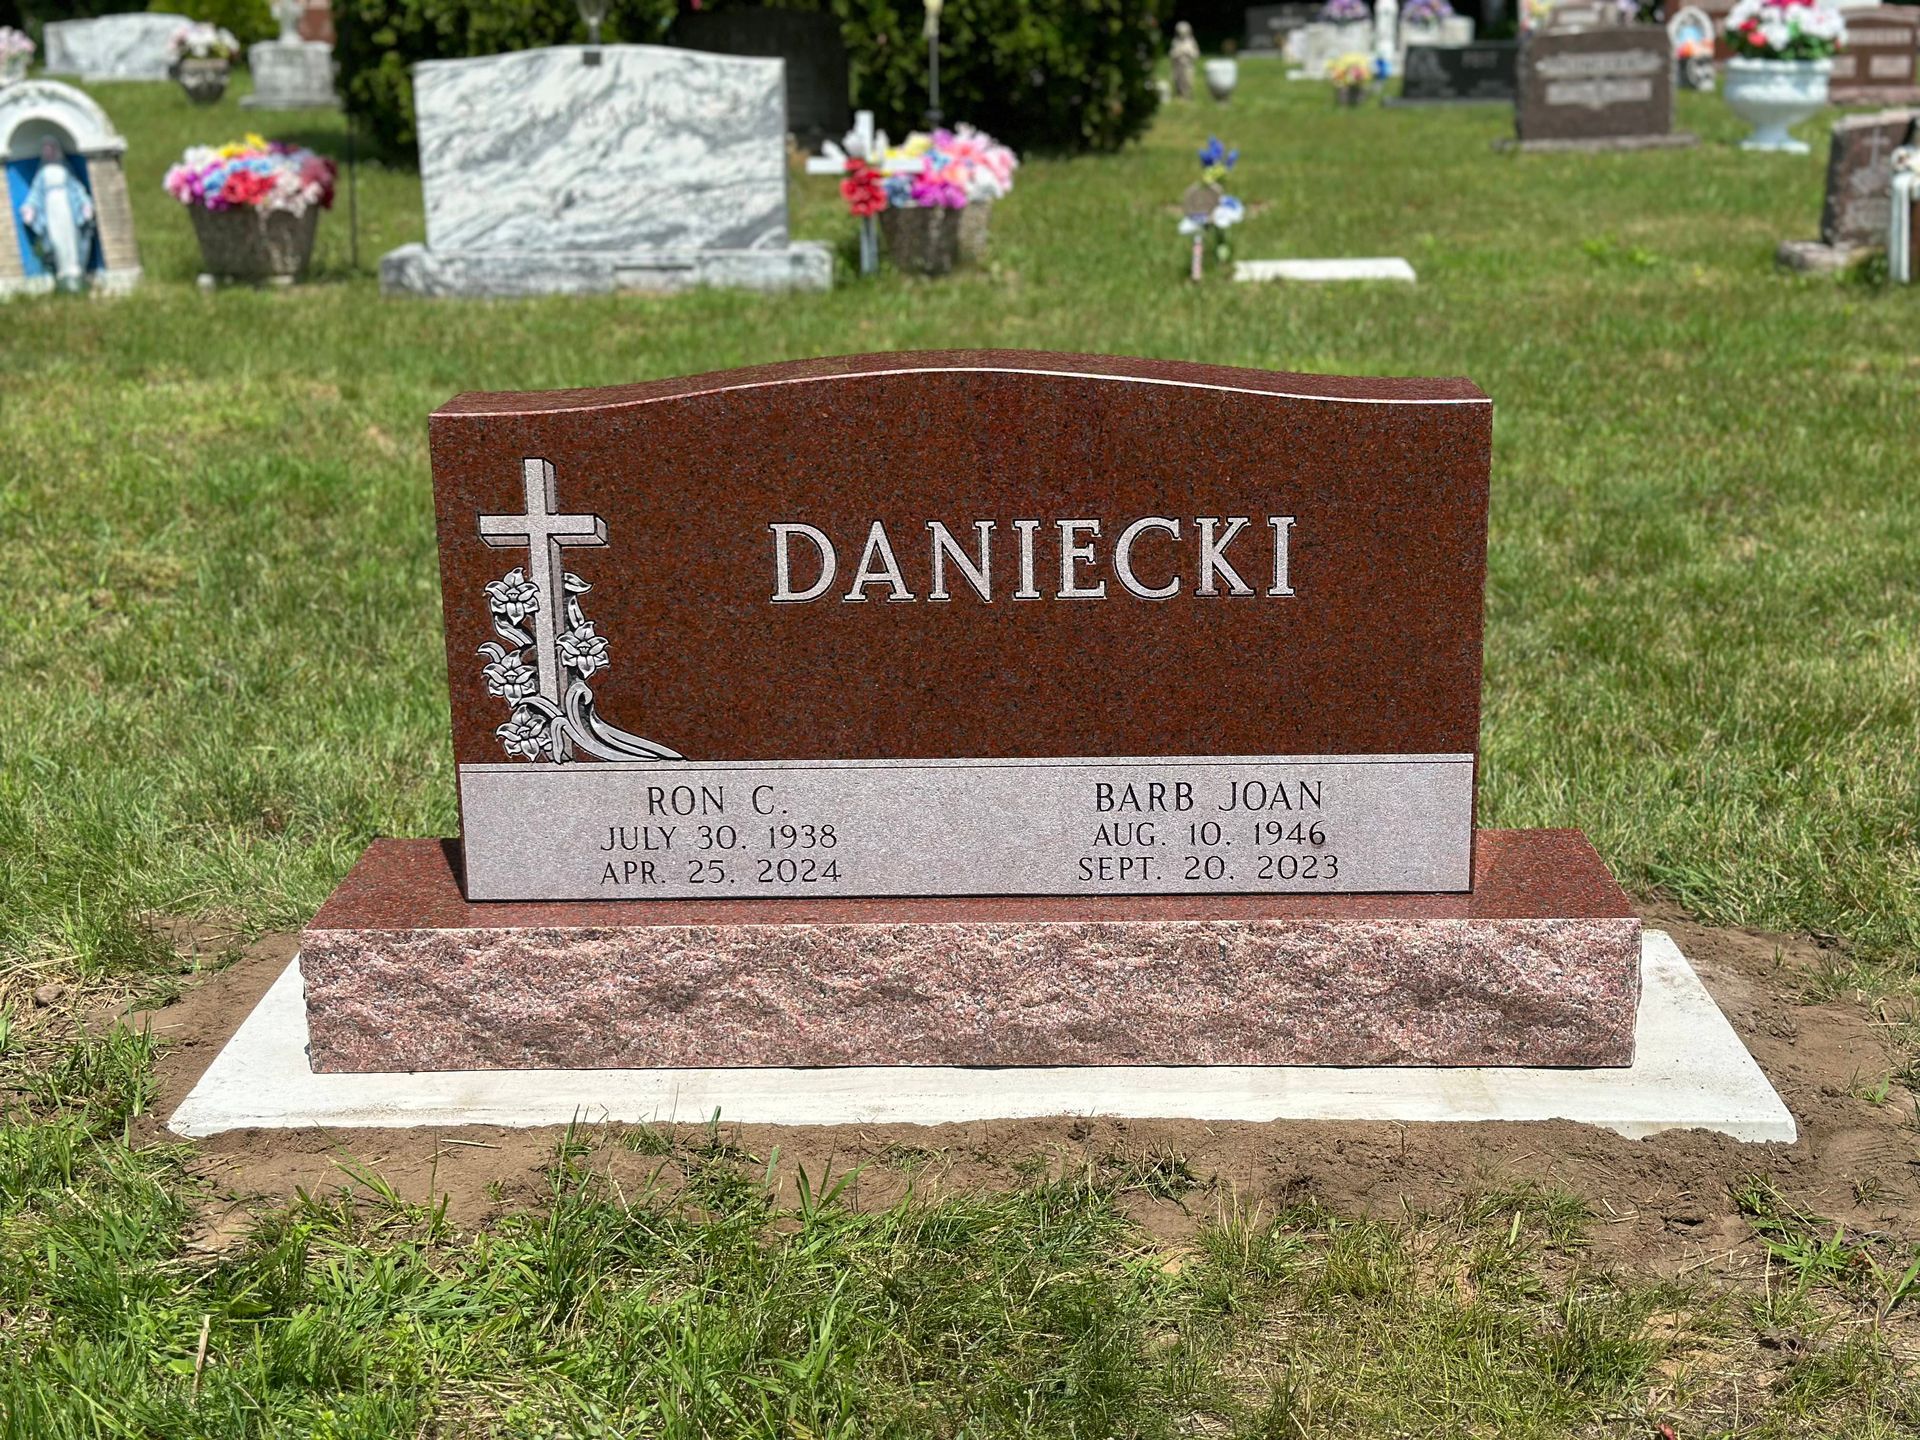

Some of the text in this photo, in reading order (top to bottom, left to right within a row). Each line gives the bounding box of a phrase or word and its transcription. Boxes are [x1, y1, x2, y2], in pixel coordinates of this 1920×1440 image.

[769, 515, 1297, 603] DANIECKI
[647, 785, 788, 816] RON C.
[1095, 780, 1323, 812] BARB JOAN
[600, 826, 677, 851] JULY
[768, 824, 838, 849] 1938
[1092, 822, 1166, 847] AUG.
[1254, 820, 1326, 846] 1946
[600, 858, 842, 885] APR. 25. 2024
[1078, 856, 1162, 881] SEPT.
[1257, 854, 1339, 880] 2023
